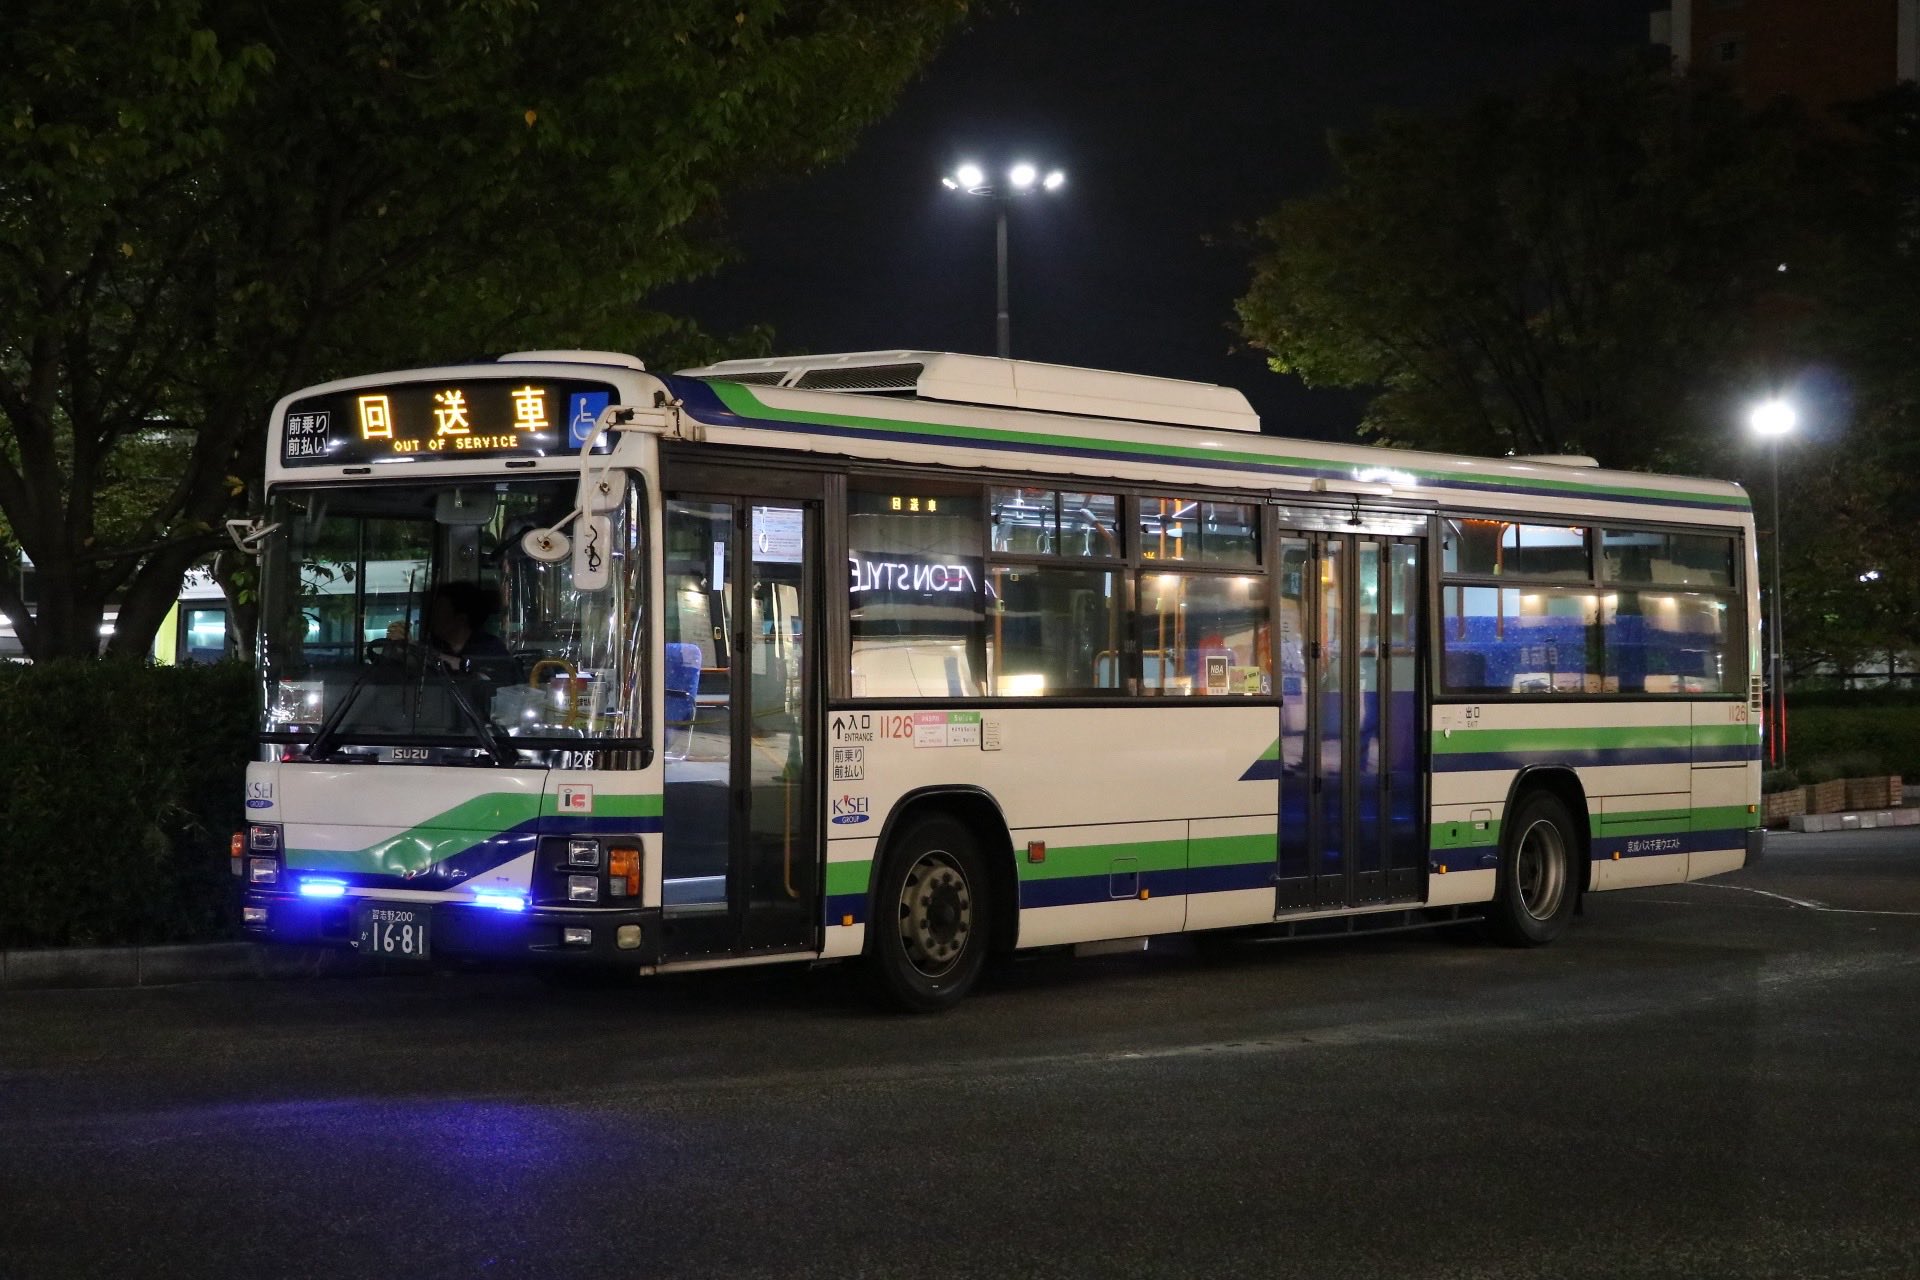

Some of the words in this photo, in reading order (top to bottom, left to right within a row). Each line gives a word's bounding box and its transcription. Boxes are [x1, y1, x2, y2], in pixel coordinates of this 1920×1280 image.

[359, 385, 549, 440] 回送車
[289, 415, 328, 435] 前乗り
[288, 436, 327, 456] 前払い
[394, 440, 419, 452] OUT
[428, 439, 446, 451] OF
[455, 435, 518, 449] SERVICE
[1465, 706, 1480, 719] 出口
[1728, 704, 1746, 722] 1126
[848, 714, 871, 730] 入口
[880, 715, 914, 739] 1126
[844, 732, 873, 742] ENTRANCE
[391, 748, 429, 760] ISUZU
[834, 749, 863, 763] 前乗り
[834, 765, 863, 779] 前払い
[841, 815, 861, 824] GROUP
[373, 922, 423, 955] 16-81
